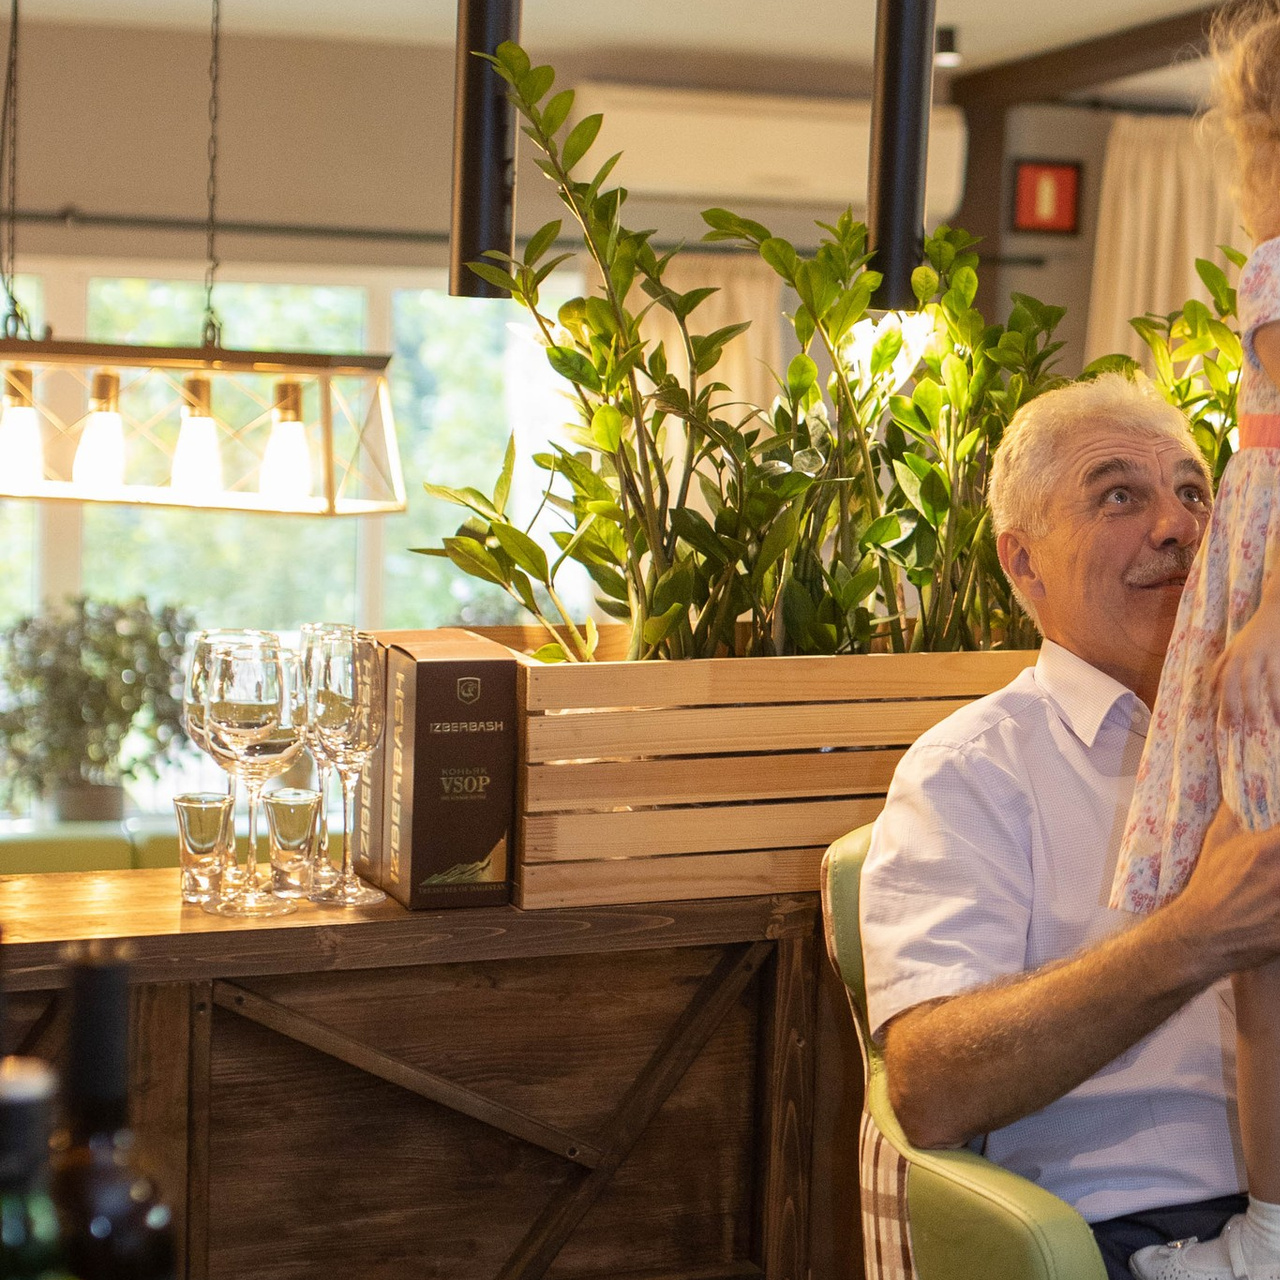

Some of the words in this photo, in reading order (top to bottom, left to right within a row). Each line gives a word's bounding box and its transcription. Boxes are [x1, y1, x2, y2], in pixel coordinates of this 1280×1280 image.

[429, 721, 504, 732] IZBERBASH
[391, 672, 405, 884] IZBERBASH
[441, 767, 488, 776] КОНЬЯК
[440, 775, 490, 793] VSOP
